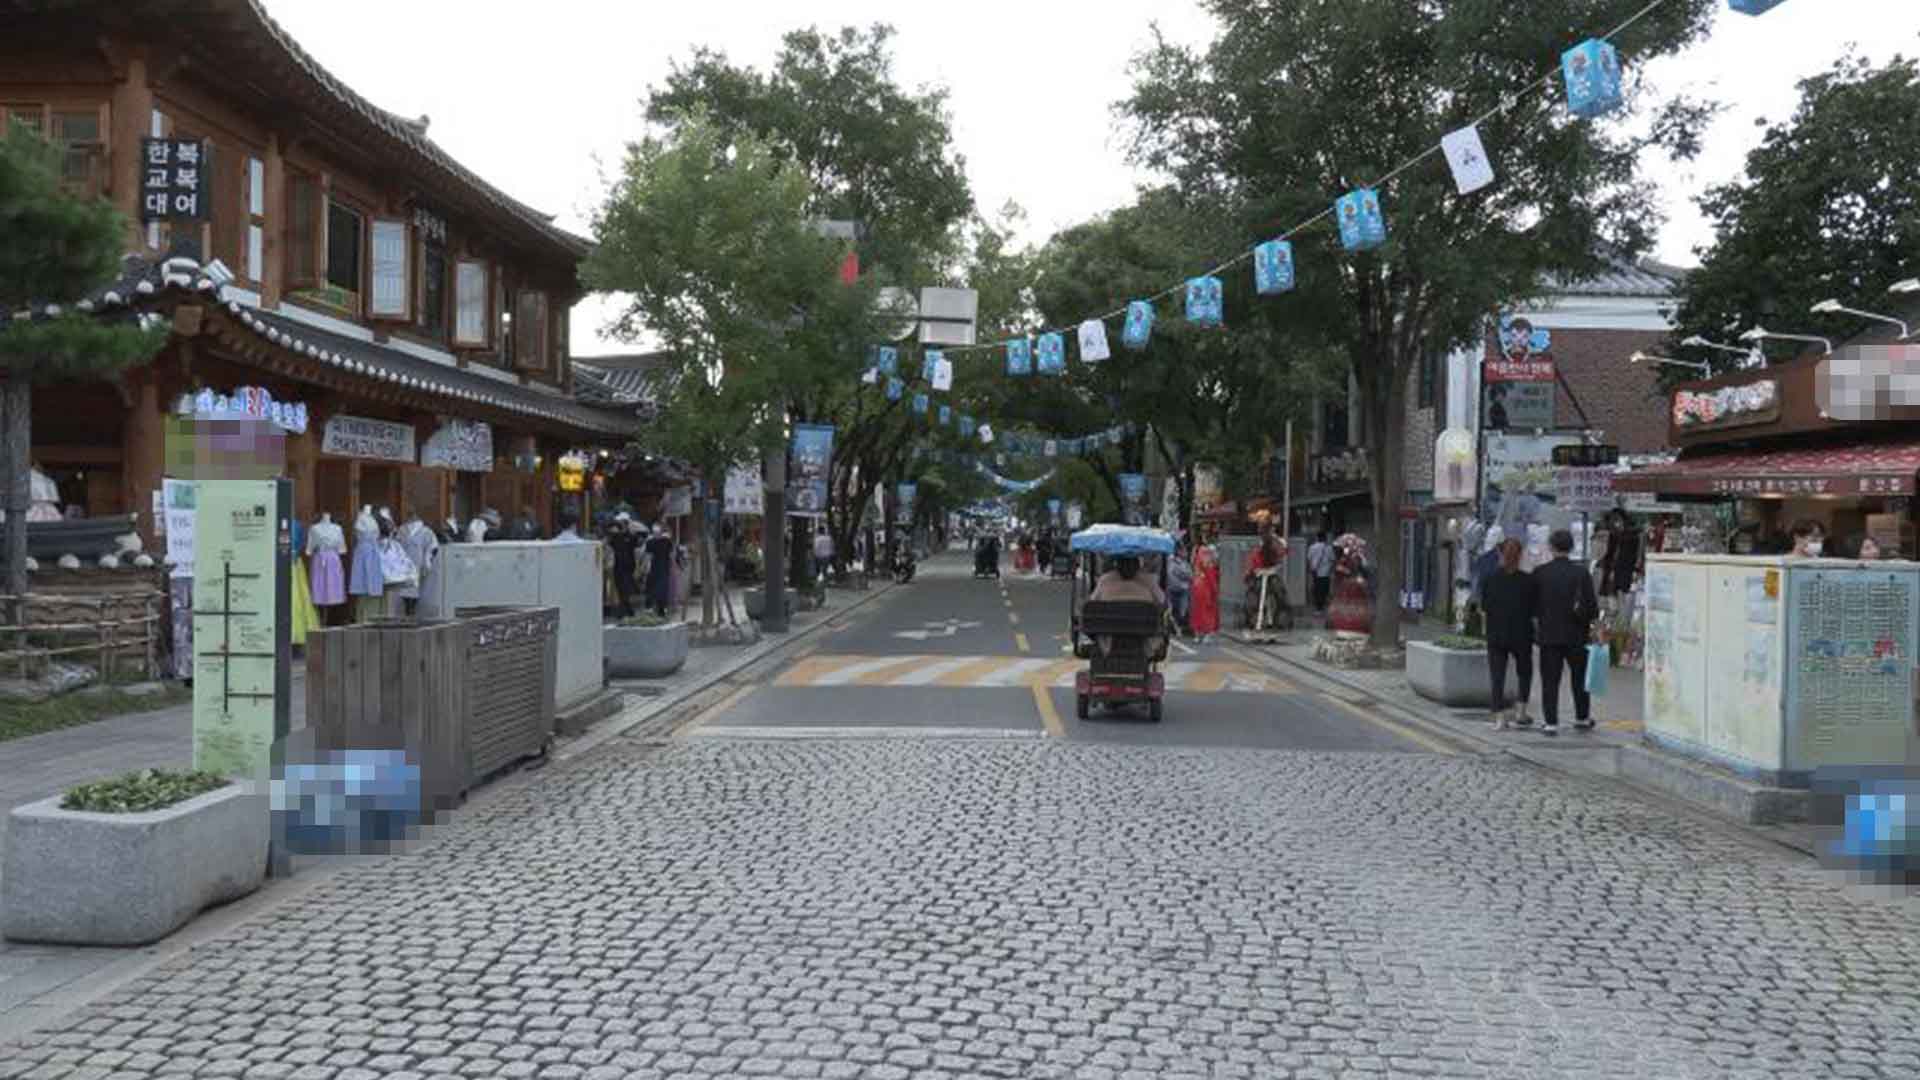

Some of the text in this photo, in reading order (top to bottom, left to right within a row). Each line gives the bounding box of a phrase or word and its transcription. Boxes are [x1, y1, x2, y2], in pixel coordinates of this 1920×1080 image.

[147, 141, 200, 164] 한복
[145, 167, 200, 190] 교복
[145, 192, 198, 216] 대여
